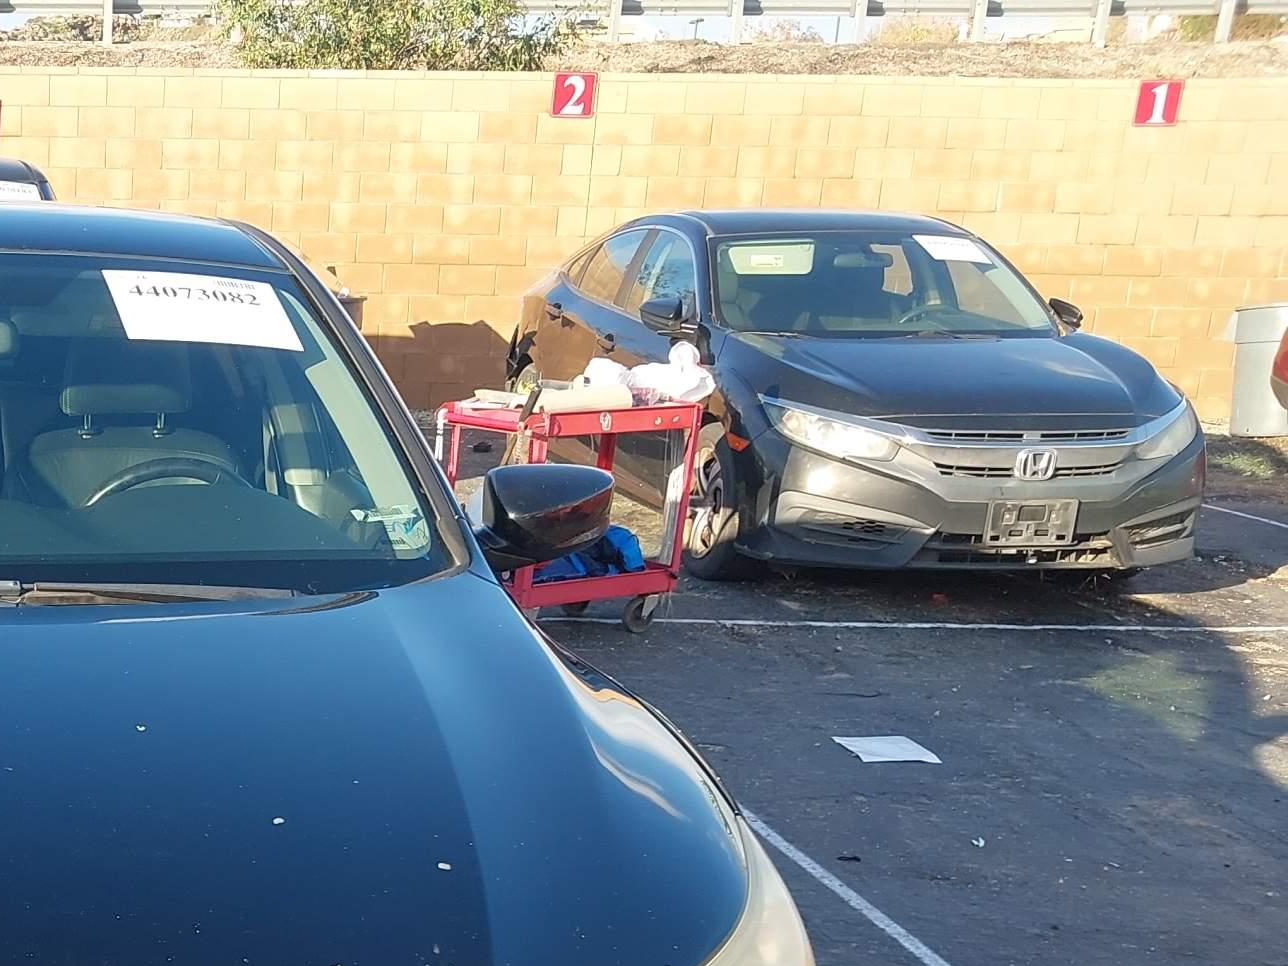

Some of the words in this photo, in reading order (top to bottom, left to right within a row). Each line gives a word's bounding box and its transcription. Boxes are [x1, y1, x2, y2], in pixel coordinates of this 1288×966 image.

[559, 75, 585, 115] 2
[1145, 83, 1169, 124] 1
[129, 284, 262, 307] 44073082
